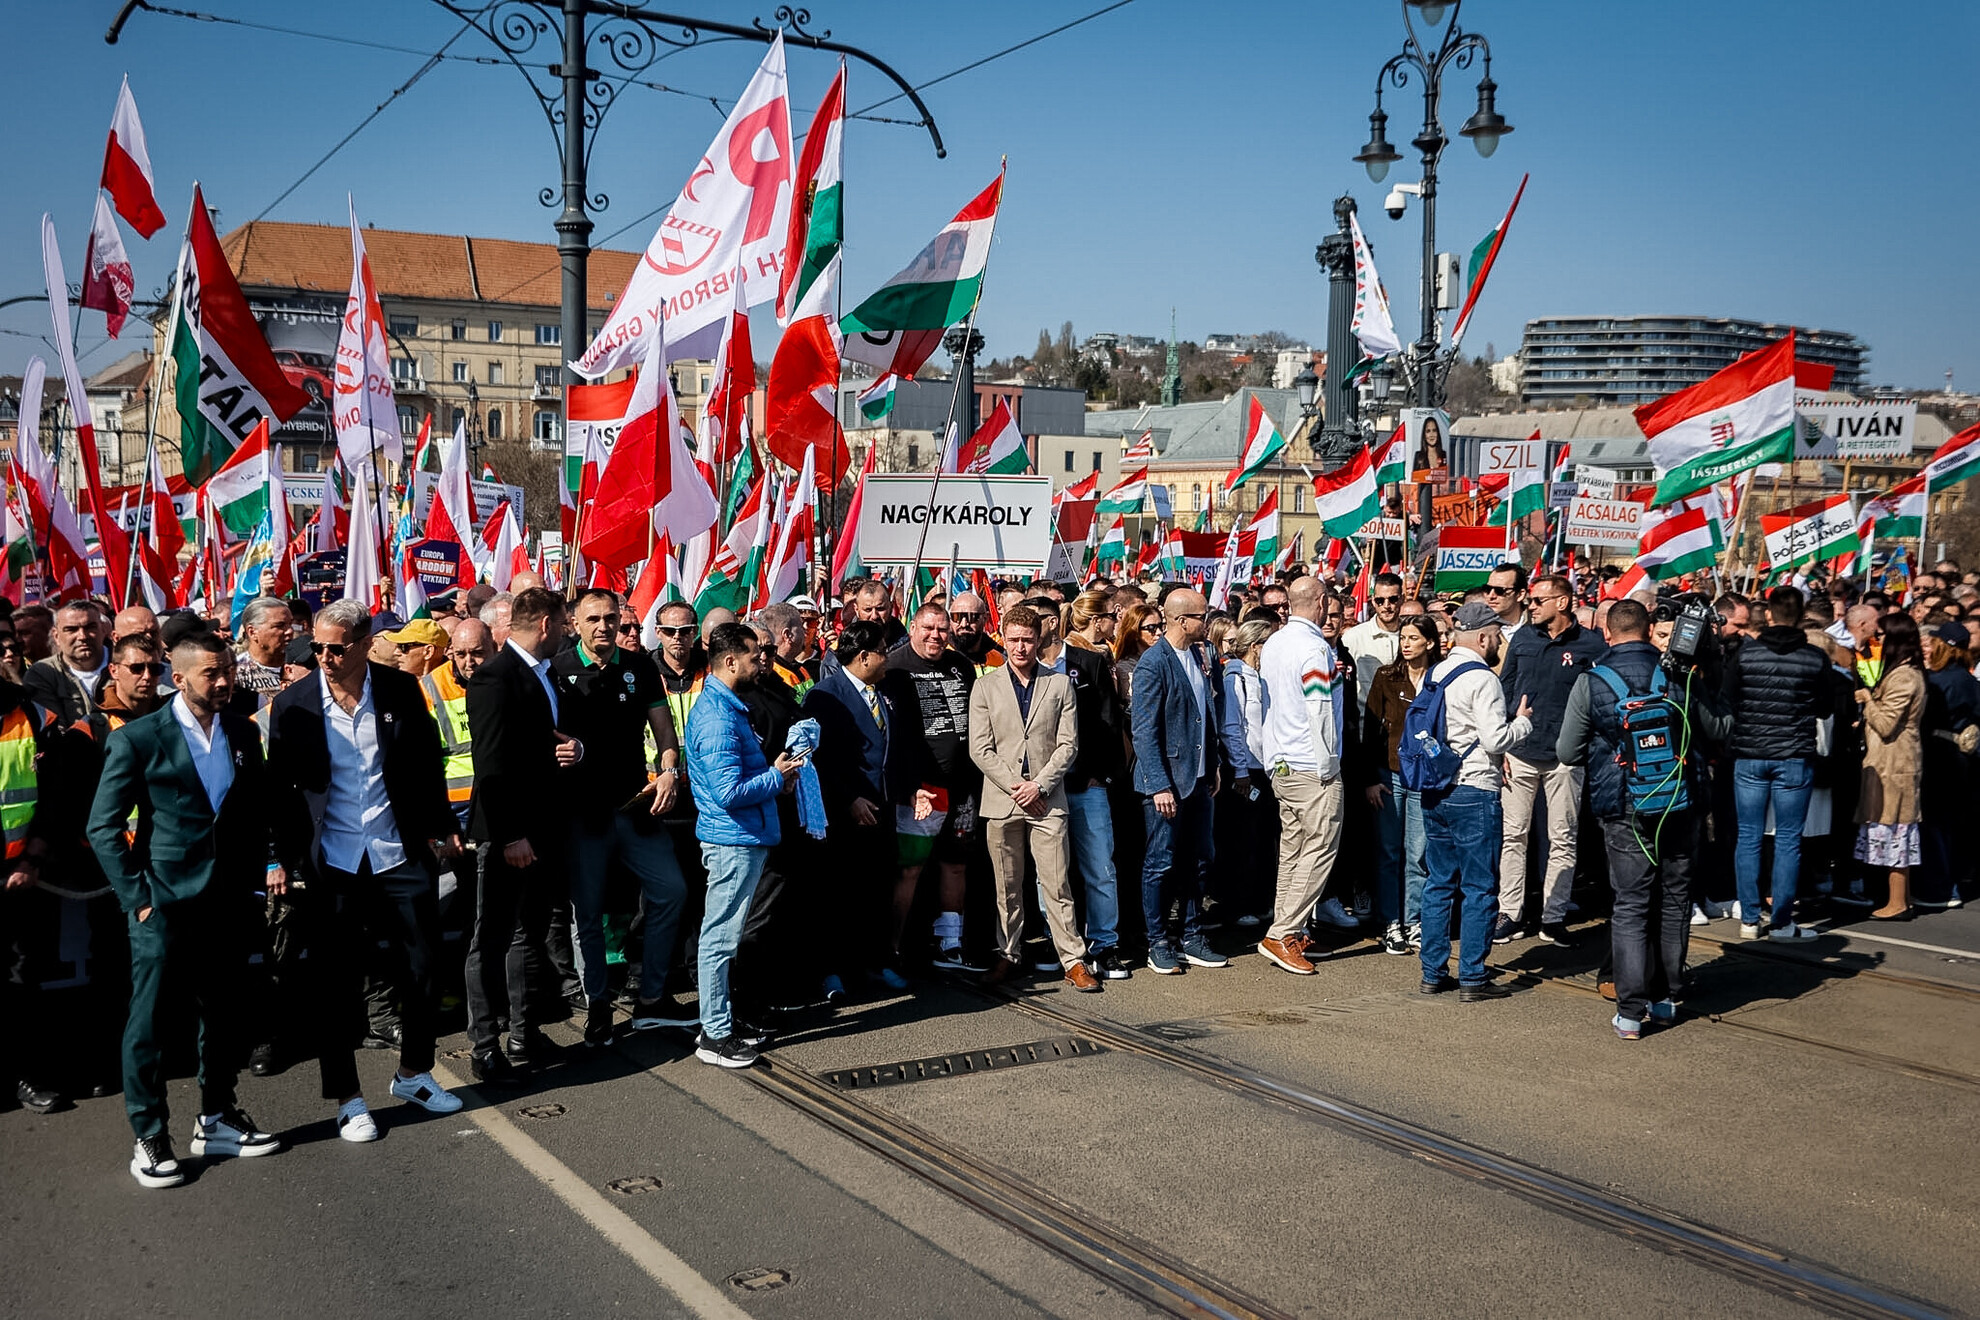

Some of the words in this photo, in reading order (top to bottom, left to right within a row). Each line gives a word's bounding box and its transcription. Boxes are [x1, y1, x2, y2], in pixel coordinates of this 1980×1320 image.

[1836, 411, 1904, 438] IVÁN
[1489, 445, 1537, 470] SZIL
[1690, 449, 1764, 480] JÁSZBERÉNY
[284, 486, 324, 499] ECSKE
[880, 501, 1033, 526] NAGYKÁROLY
[1575, 502, 1638, 523] ACSALAG
[1358, 521, 1402, 537] SORNA
[420, 549, 445, 560] EUROPA
[1438, 549, 1506, 570] JÁSZSÁG
[416, 561, 455, 574] ARODÓW
